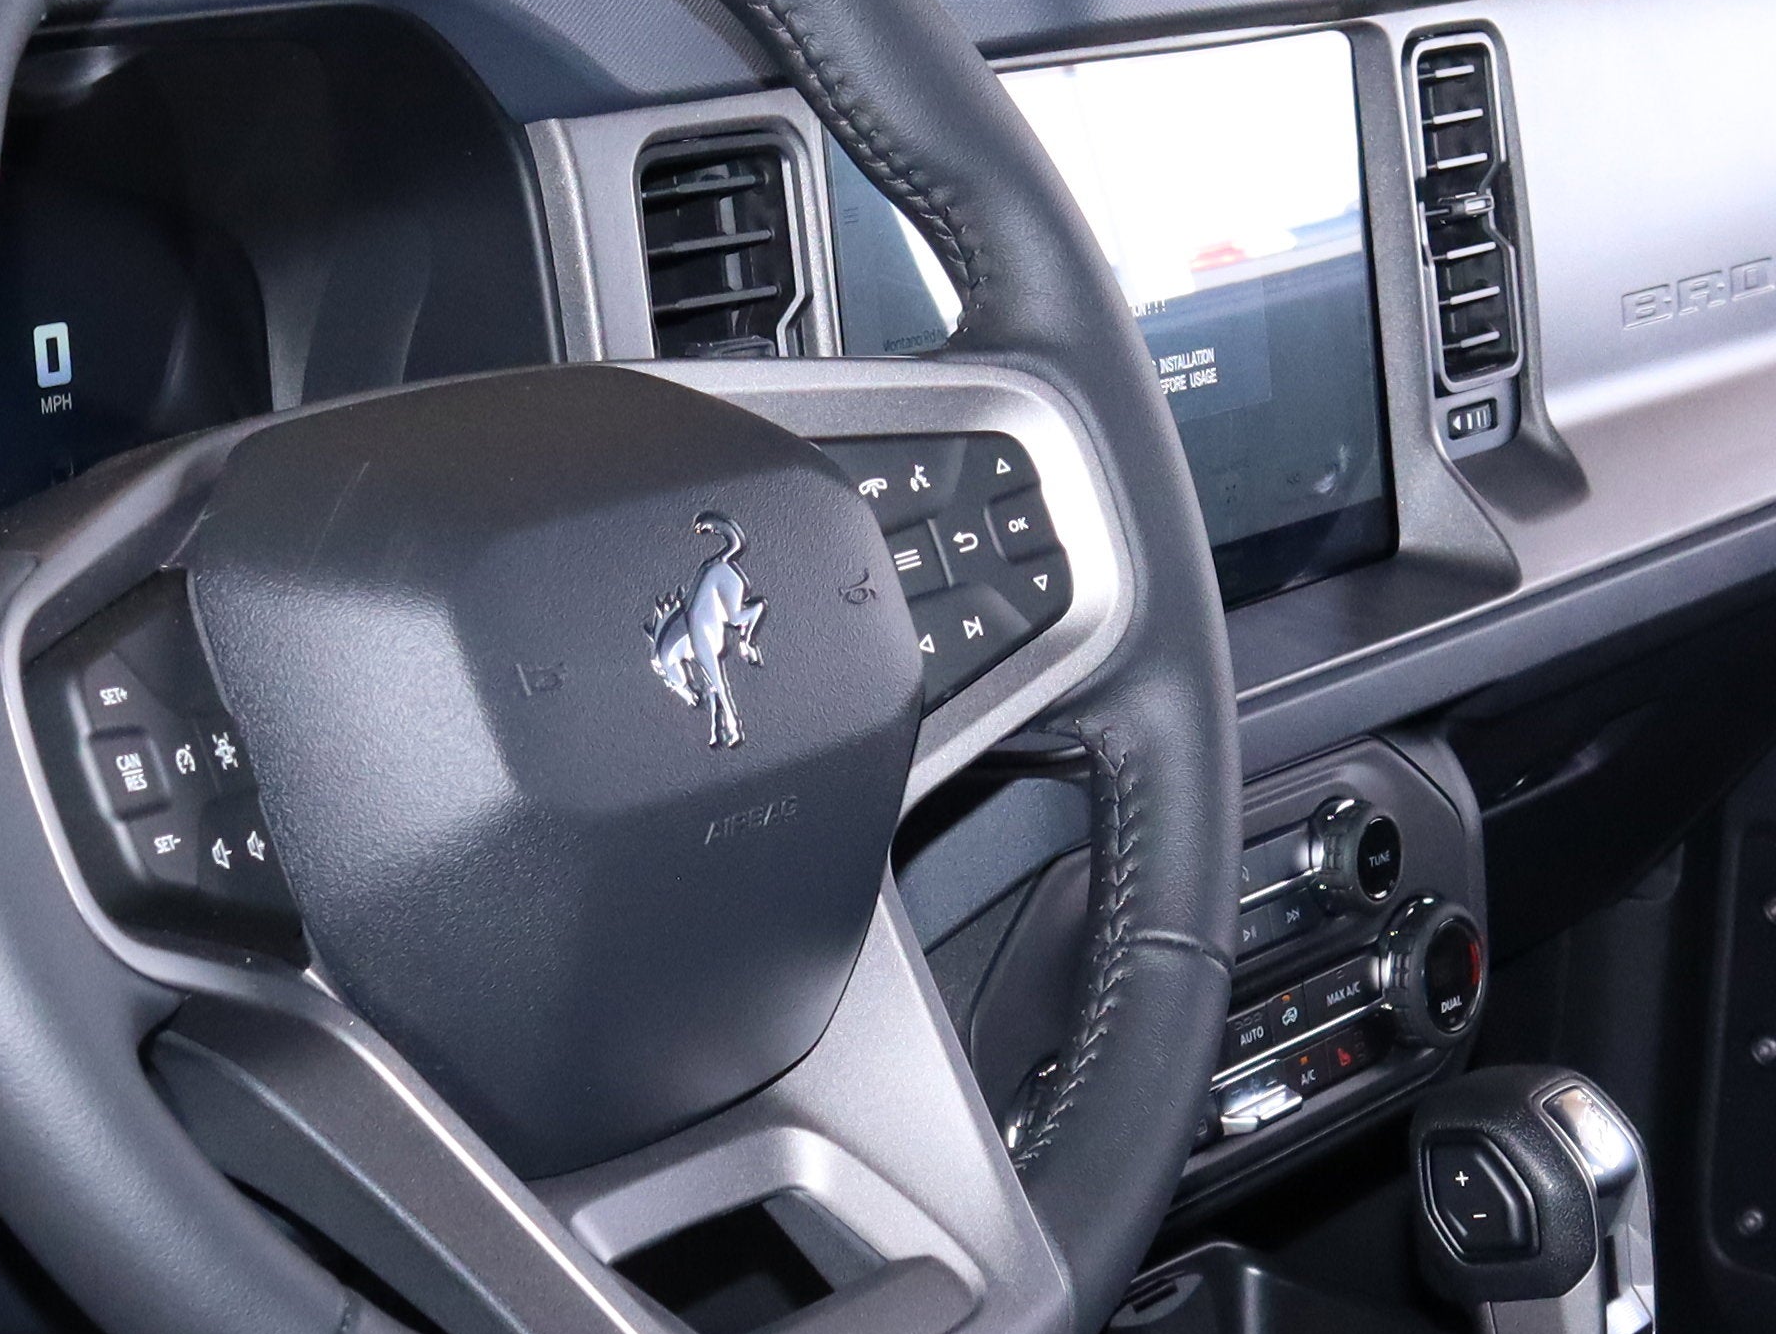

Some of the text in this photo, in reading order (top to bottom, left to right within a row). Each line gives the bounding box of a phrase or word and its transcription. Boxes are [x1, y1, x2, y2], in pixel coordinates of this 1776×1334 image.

[33, 321, 73, 389] 0
[1159, 347, 1215, 374] INSTALLATION
[1189, 367, 1218, 388] USAGE
[40, 393, 73, 415] MPH
[1008, 516, 1029, 534] OK
[115, 752, 142, 773] CAN
[125, 773, 148, 793] RES
[704, 795, 799, 846] AIRBAG
[1368, 849, 1392, 868] TUNE
[1326, 980, 1362, 1008] MAX A/C
[1440, 995, 1463, 1014] DUAL
[1240, 1025, 1265, 1046] AUTO
[1300, 1069, 1317, 1086] A/C
